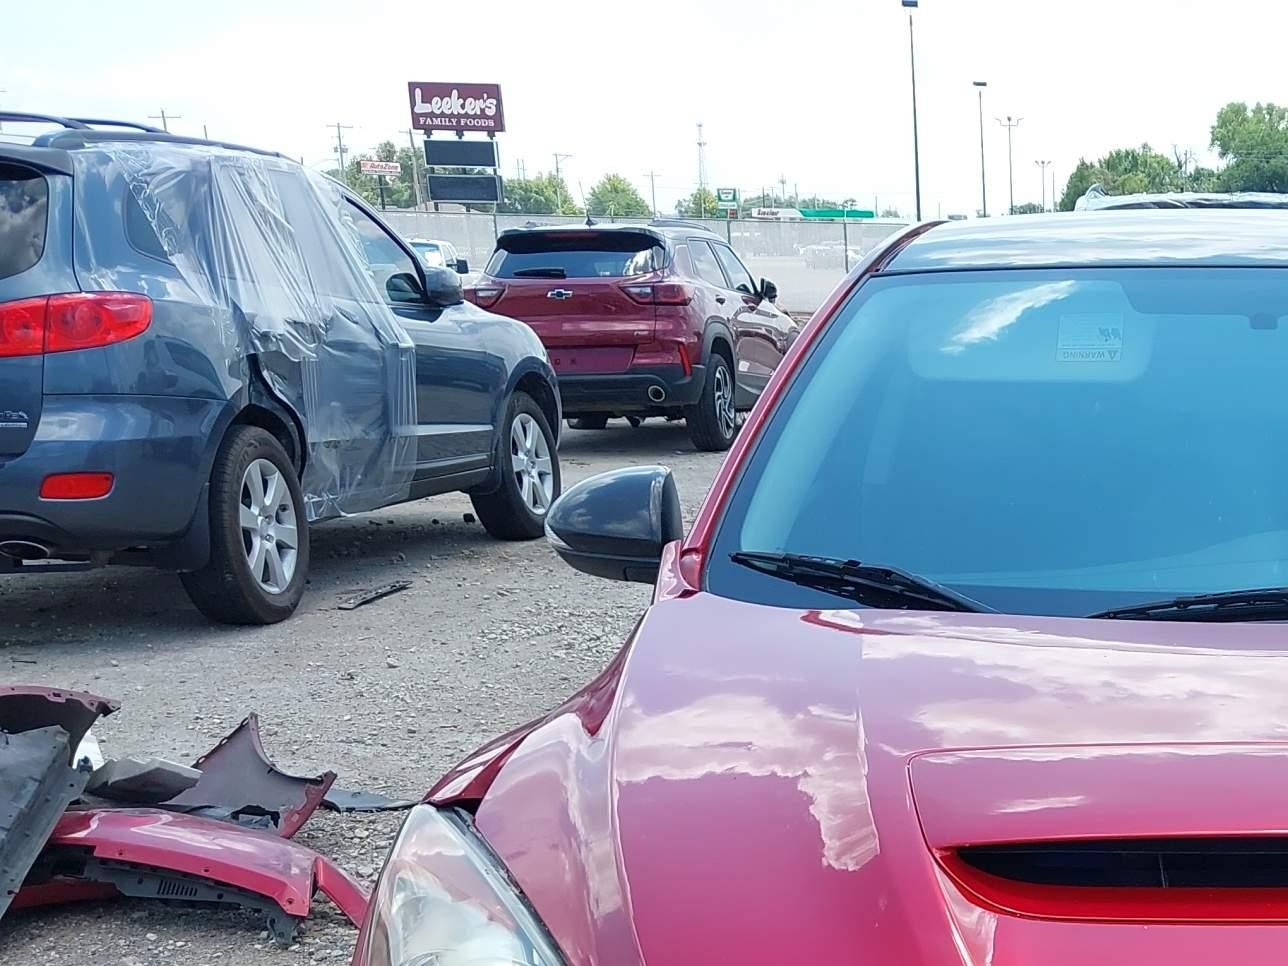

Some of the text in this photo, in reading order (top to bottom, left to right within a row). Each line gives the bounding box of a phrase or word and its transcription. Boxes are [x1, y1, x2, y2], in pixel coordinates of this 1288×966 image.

[413, 88, 496, 116] Leeker's
[419, 118, 495, 127] FAMILY FOODS
